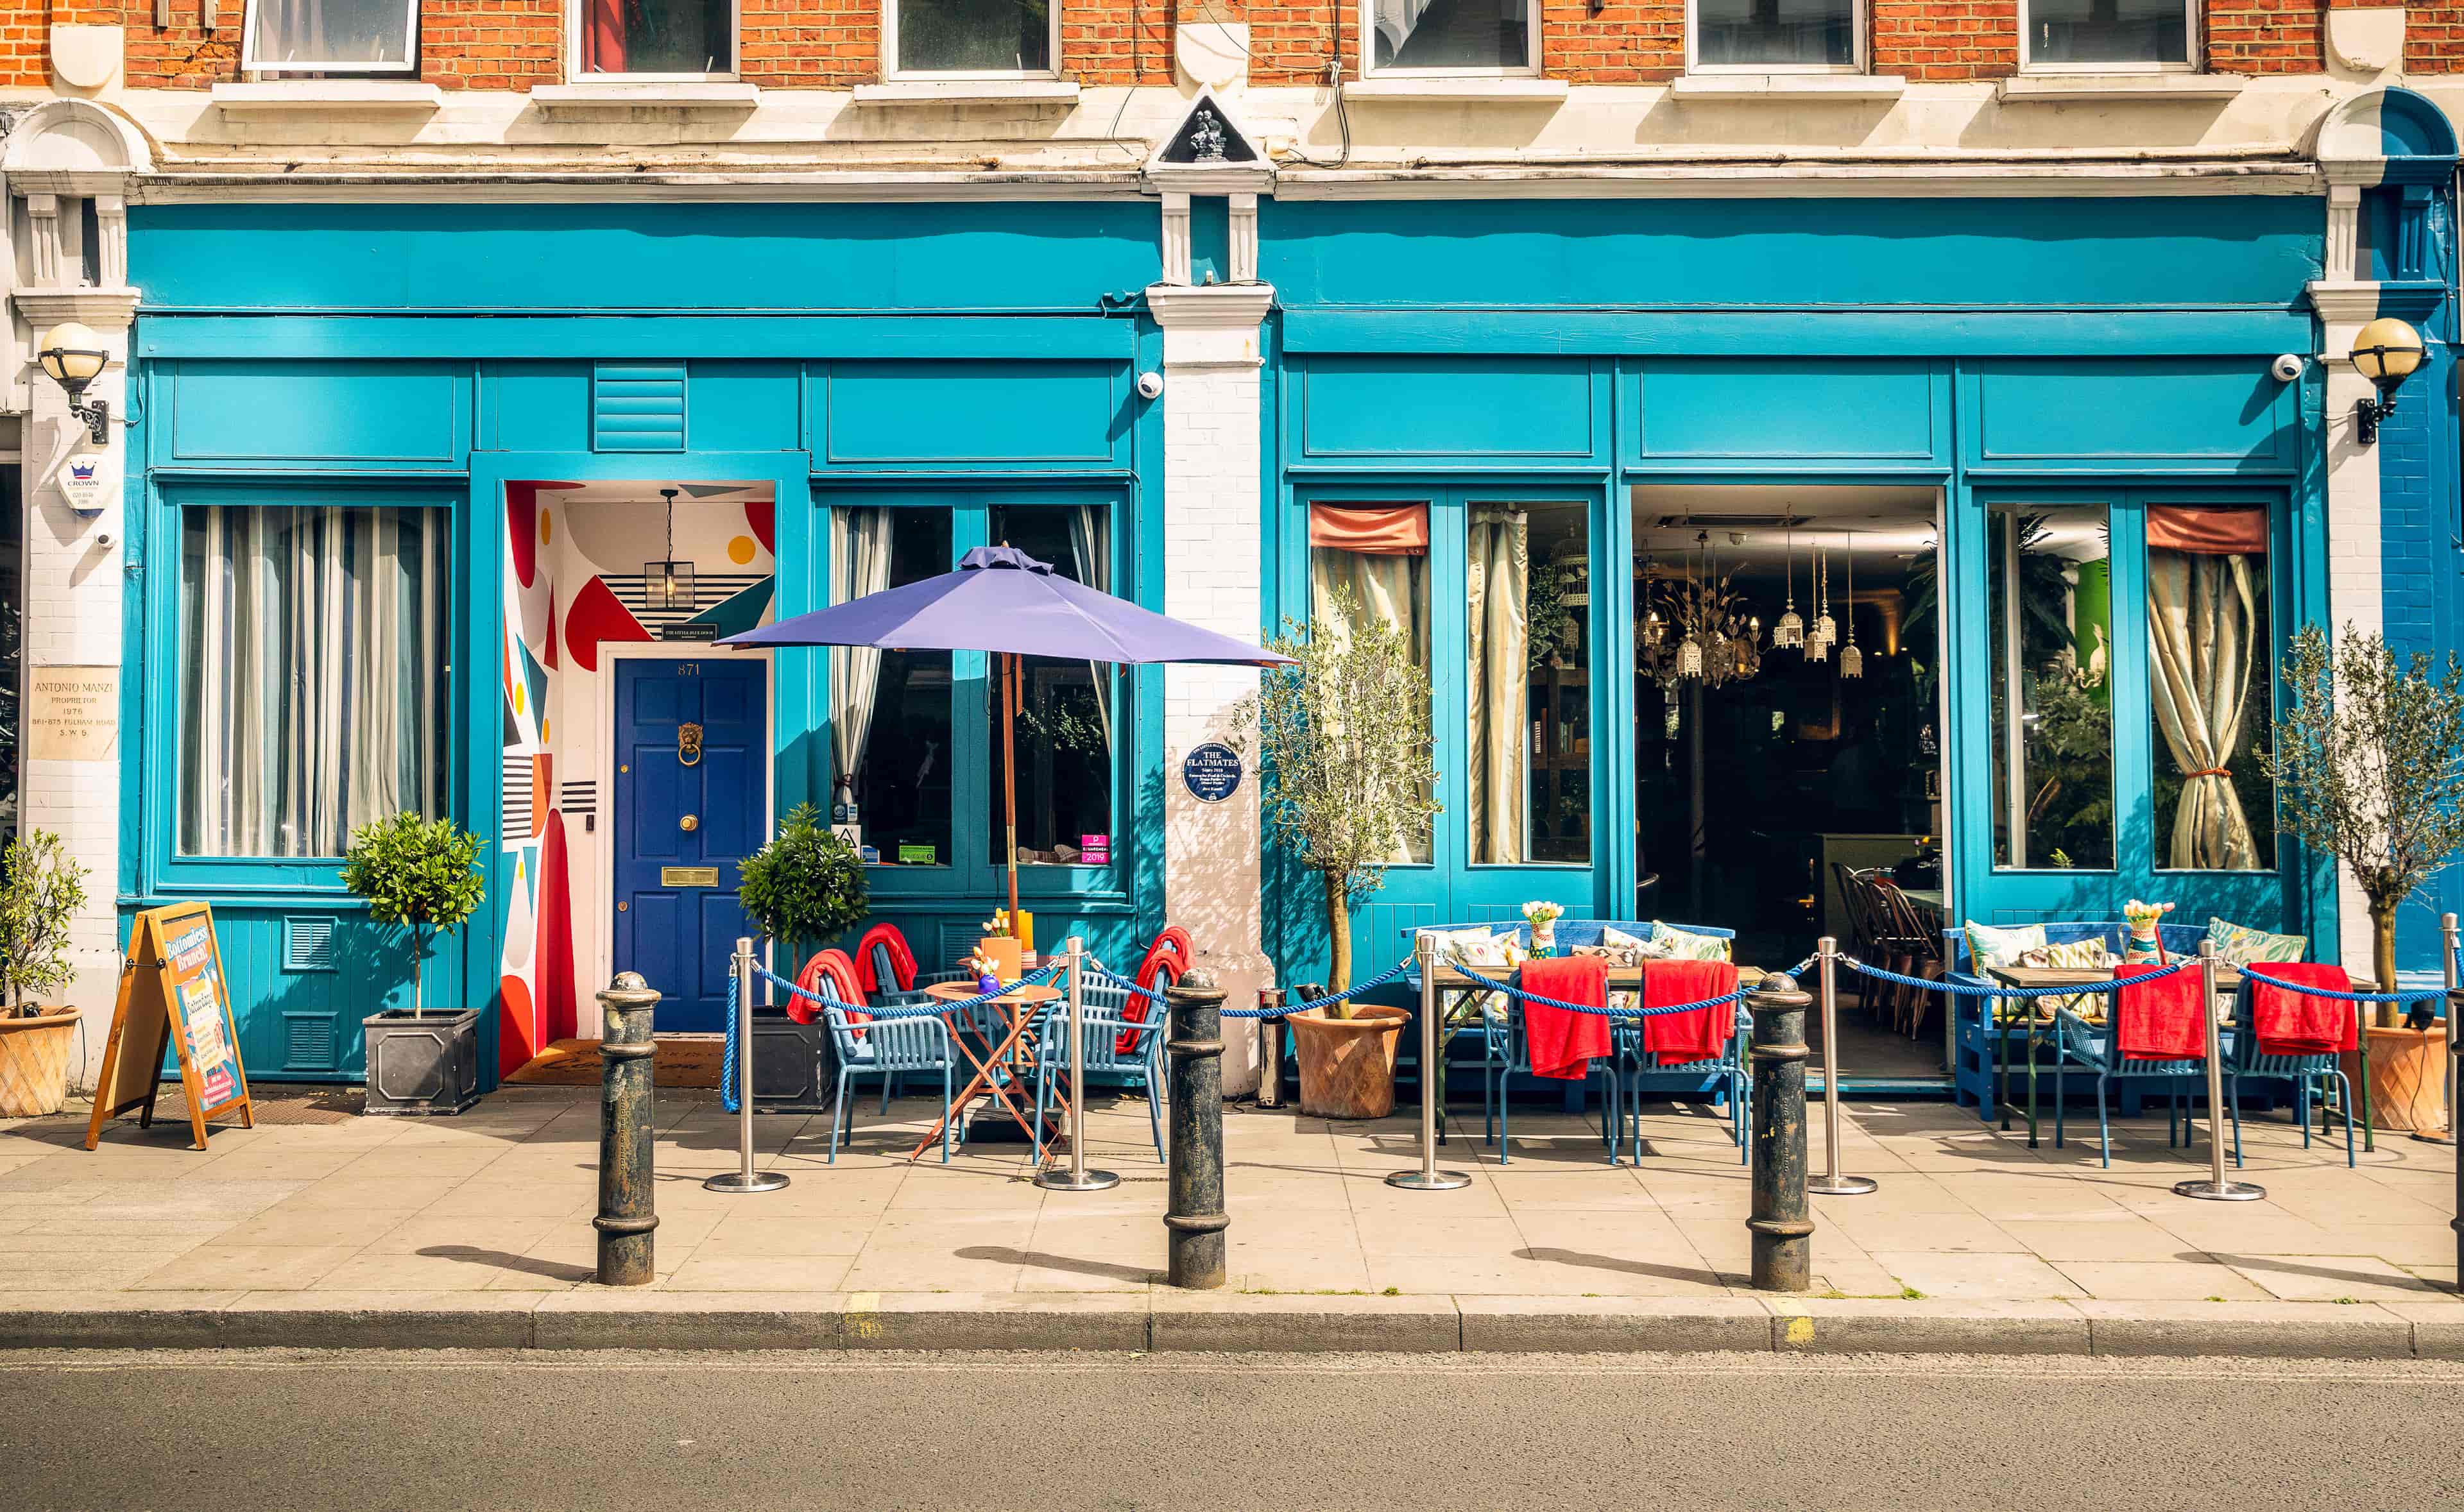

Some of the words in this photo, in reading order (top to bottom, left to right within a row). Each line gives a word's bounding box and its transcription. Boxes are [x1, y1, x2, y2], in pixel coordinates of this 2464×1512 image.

[678, 663, 699, 676] 871
[35, 683, 79, 692] ANTONIO
[82, 683, 112, 692] MANZI
[166, 924, 209, 961] Bottomless
[176, 942, 209, 973] Brunch!
[187, 992, 213, 1016] Saturdays
